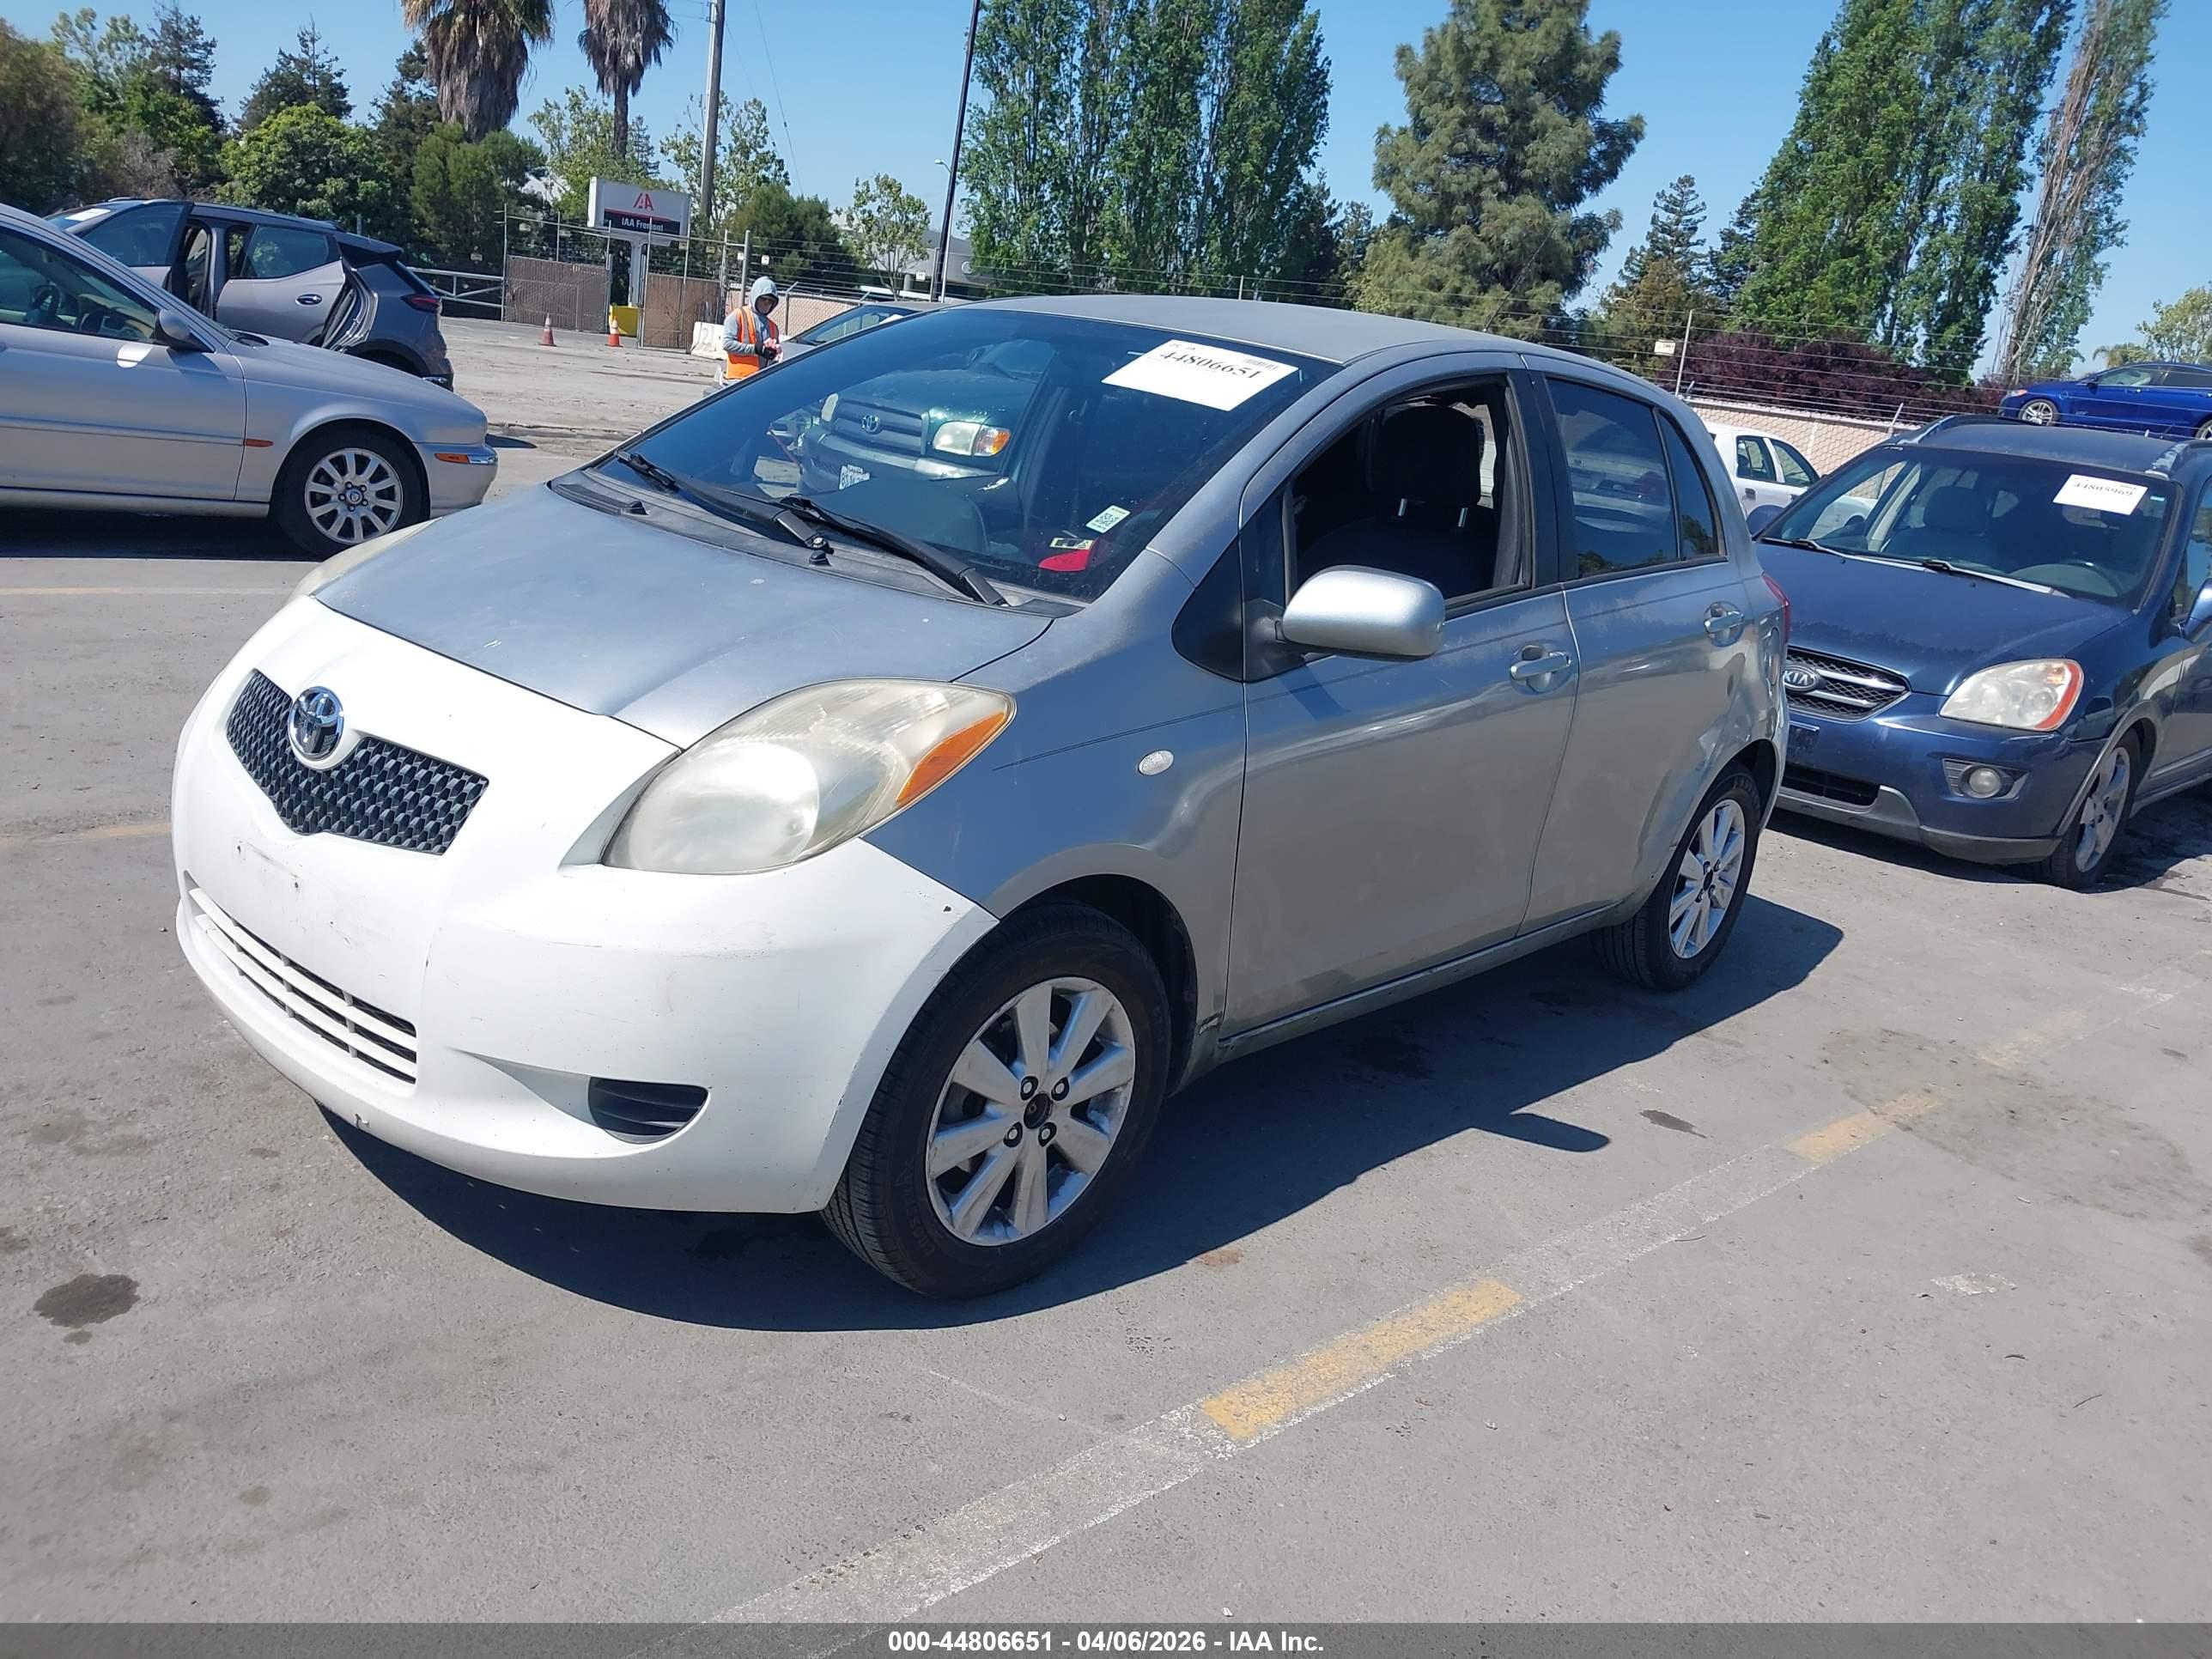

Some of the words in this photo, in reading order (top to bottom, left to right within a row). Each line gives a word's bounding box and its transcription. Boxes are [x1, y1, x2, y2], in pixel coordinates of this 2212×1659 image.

[622, 216, 635, 228] IAA
[636, 219, 664, 232] Fremont
[1159, 351, 1261, 378] 44806651
[1783, 670, 1808, 685] KIA
